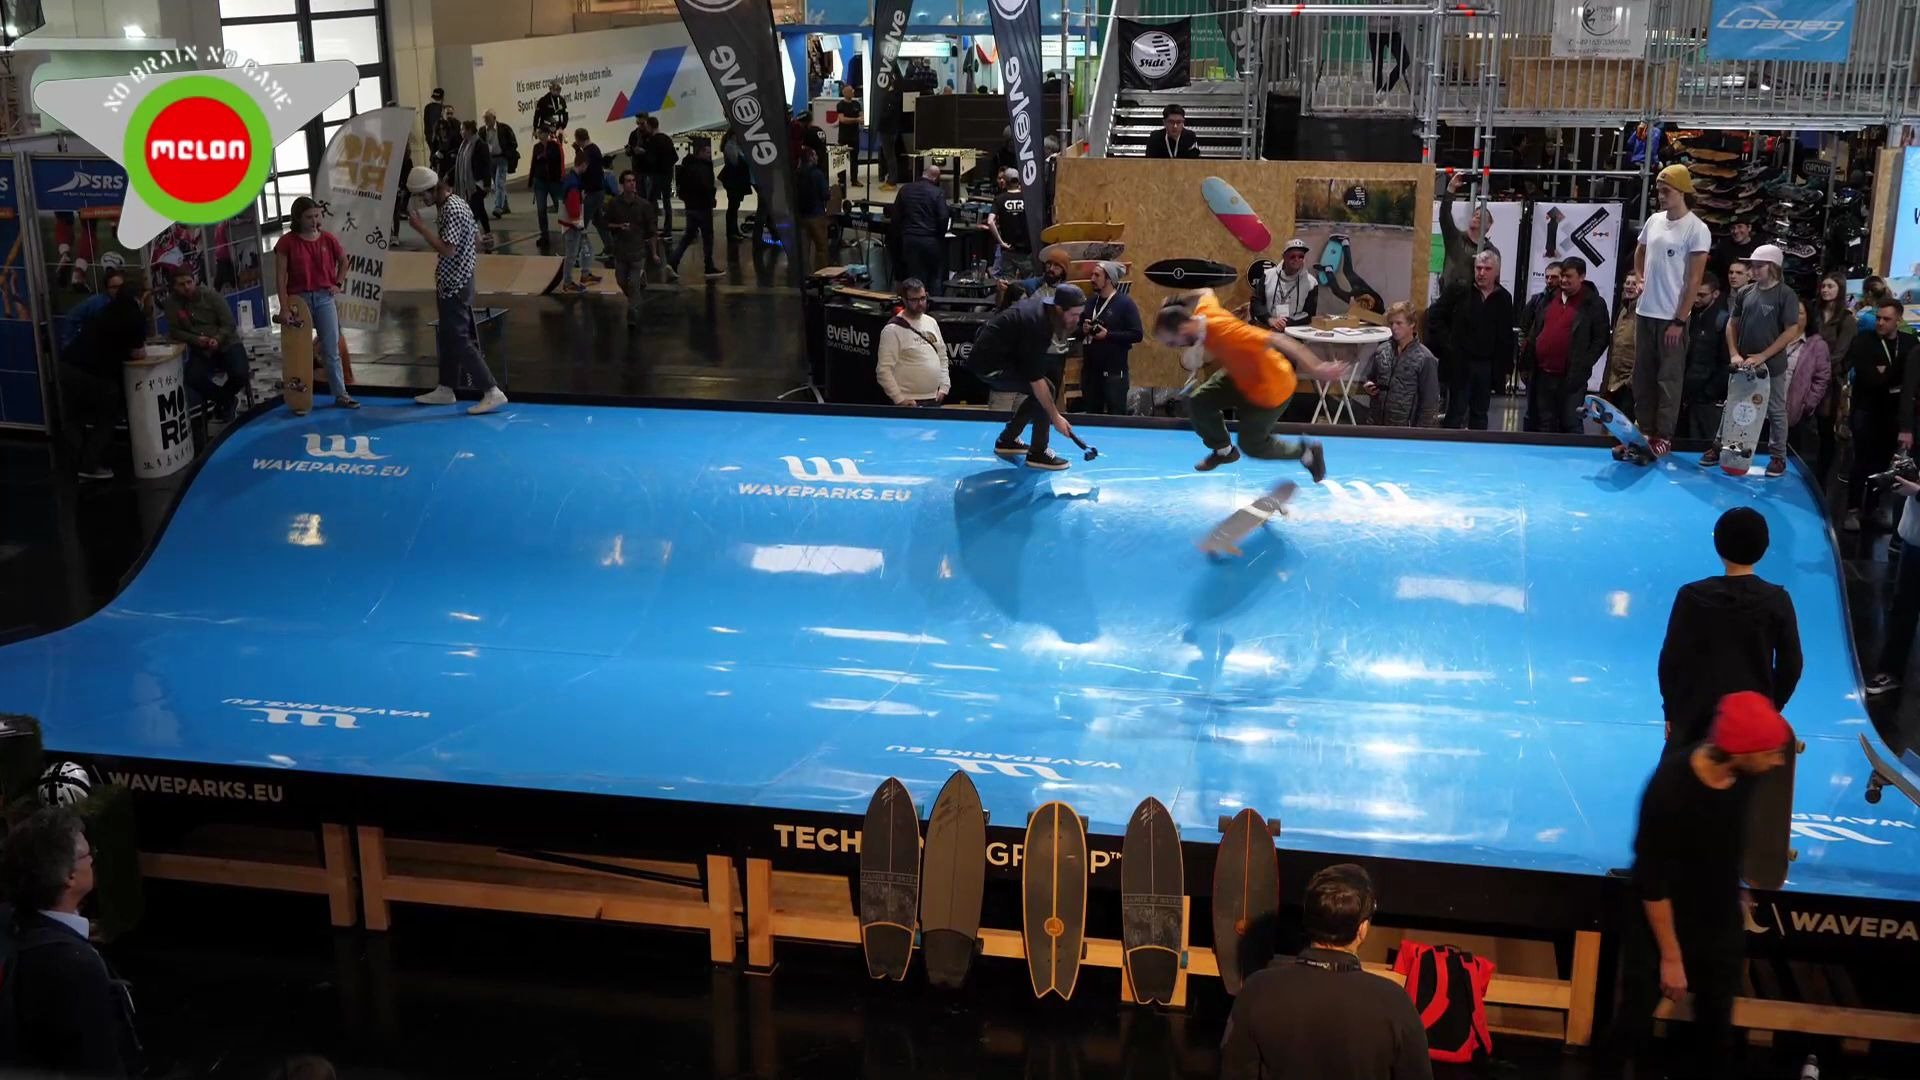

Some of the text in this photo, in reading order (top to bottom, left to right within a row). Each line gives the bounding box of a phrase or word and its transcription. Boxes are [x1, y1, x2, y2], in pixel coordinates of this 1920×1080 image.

[525, 79, 541, 92] never
[565, 73, 579, 86] along
[579, 71, 588, 82] the
[588, 69, 600, 81] extra
[601, 67, 613, 79] mile.
[517, 98, 534, 115] Sport
[573, 91, 583, 101] Are
[583, 91, 592, 103] you
[709, 45, 778, 165] evolve
[1005, 56, 1037, 186] evolve
[91, 175, 124, 190] SRS
[826, 324, 870, 348] evolve
[252, 458, 409, 477] WAVEPARKS.EU
[738, 482, 912, 501] WAVEPARKS.EU
[220, 698, 430, 718] WAVEPARKS.EU
[885, 745, 1122, 769] WAVEPARKS.EU
[107, 771, 283, 802] WAVEPARKS.EU
